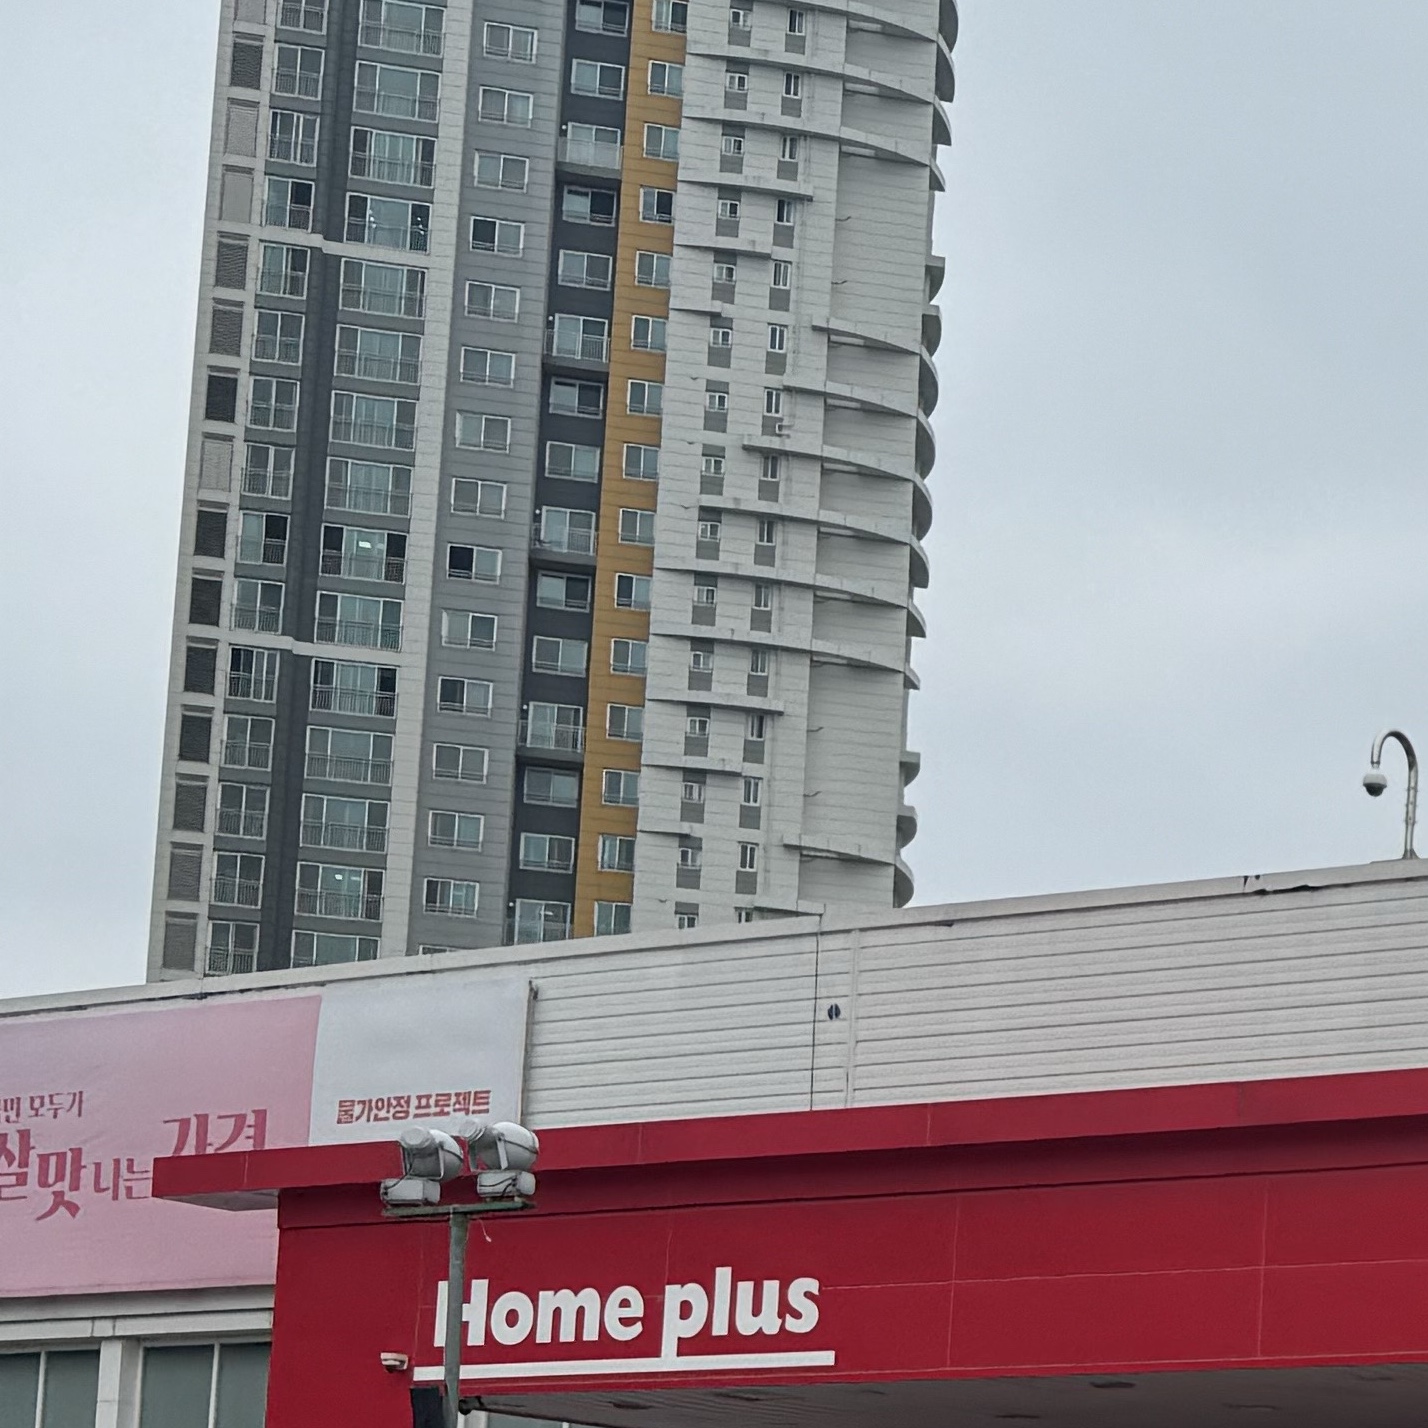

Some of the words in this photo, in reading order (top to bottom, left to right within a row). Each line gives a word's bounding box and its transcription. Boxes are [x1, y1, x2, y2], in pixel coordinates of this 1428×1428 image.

[337, 1095, 410, 1124] 물가안정
[412, 1090, 491, 1119] 프로젝트
[434, 1279, 644, 1346] Home
[662, 1267, 820, 1358] plus
